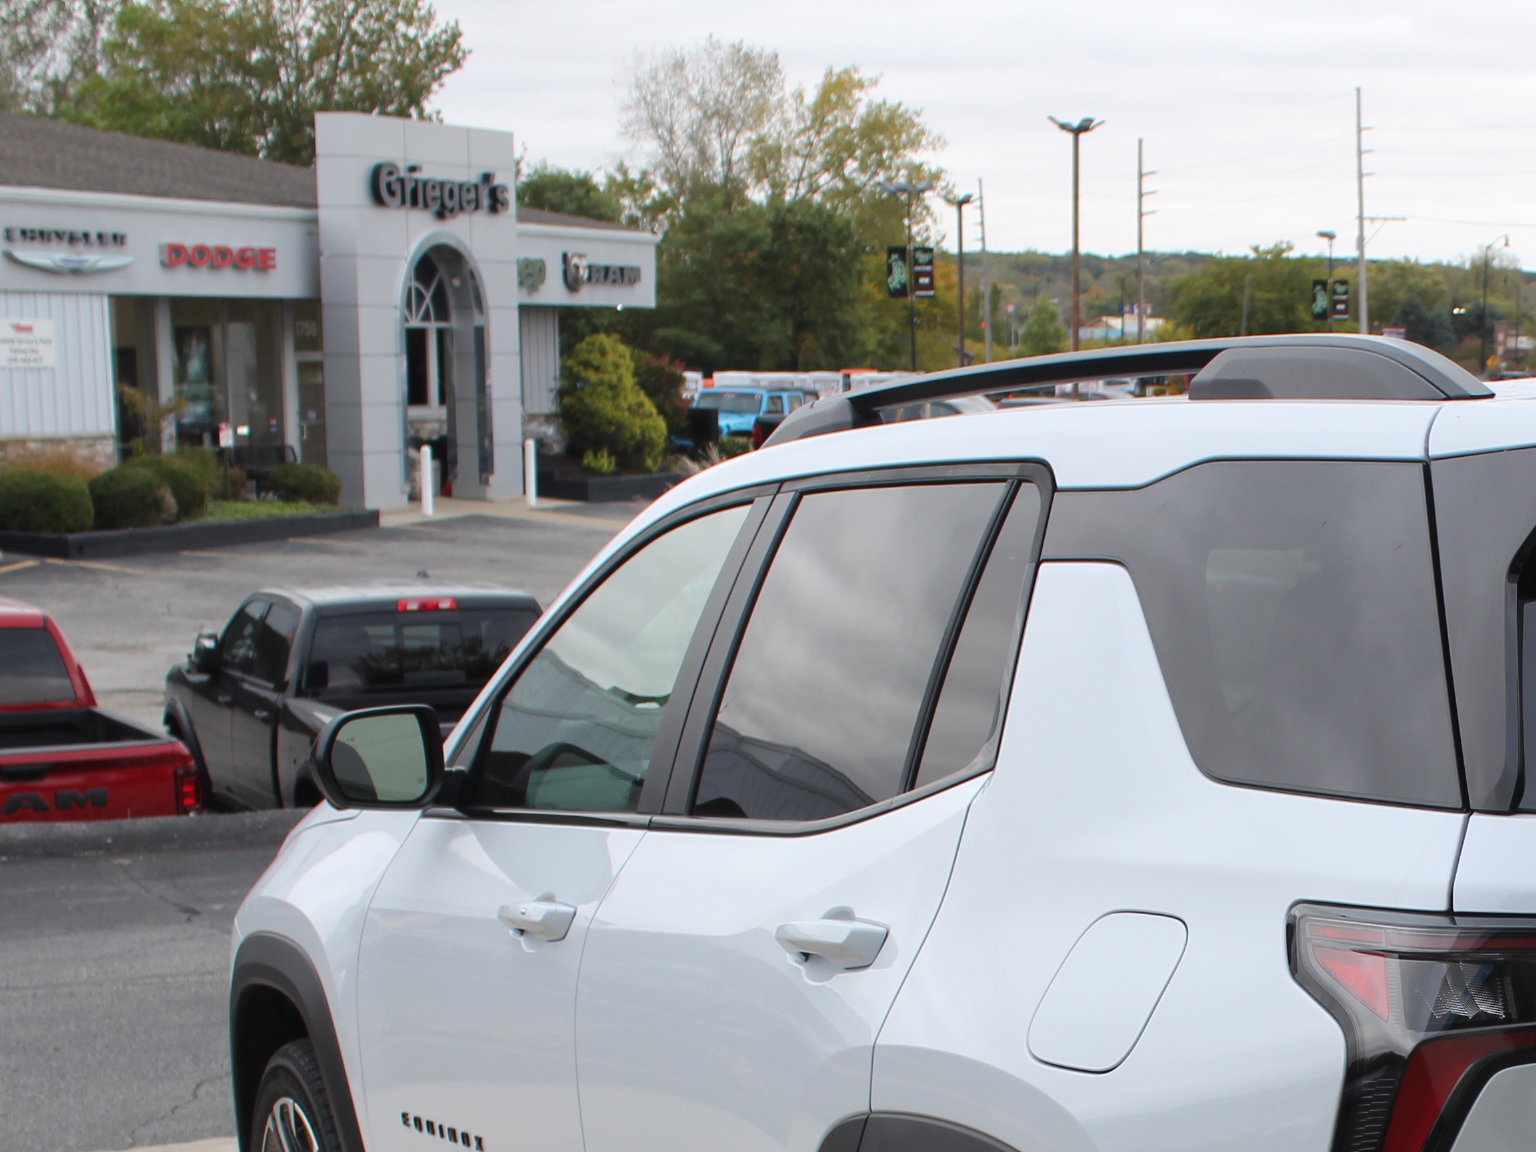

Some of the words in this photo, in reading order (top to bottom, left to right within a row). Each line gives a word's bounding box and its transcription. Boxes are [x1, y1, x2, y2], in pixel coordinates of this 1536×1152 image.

[371, 162, 509, 219] Grieger's
[162, 243, 277, 270] DODGE
[589, 263, 642, 286] RAM
[0, 787, 109, 813] AM
[401, 1111, 485, 1152] EQUINOX
